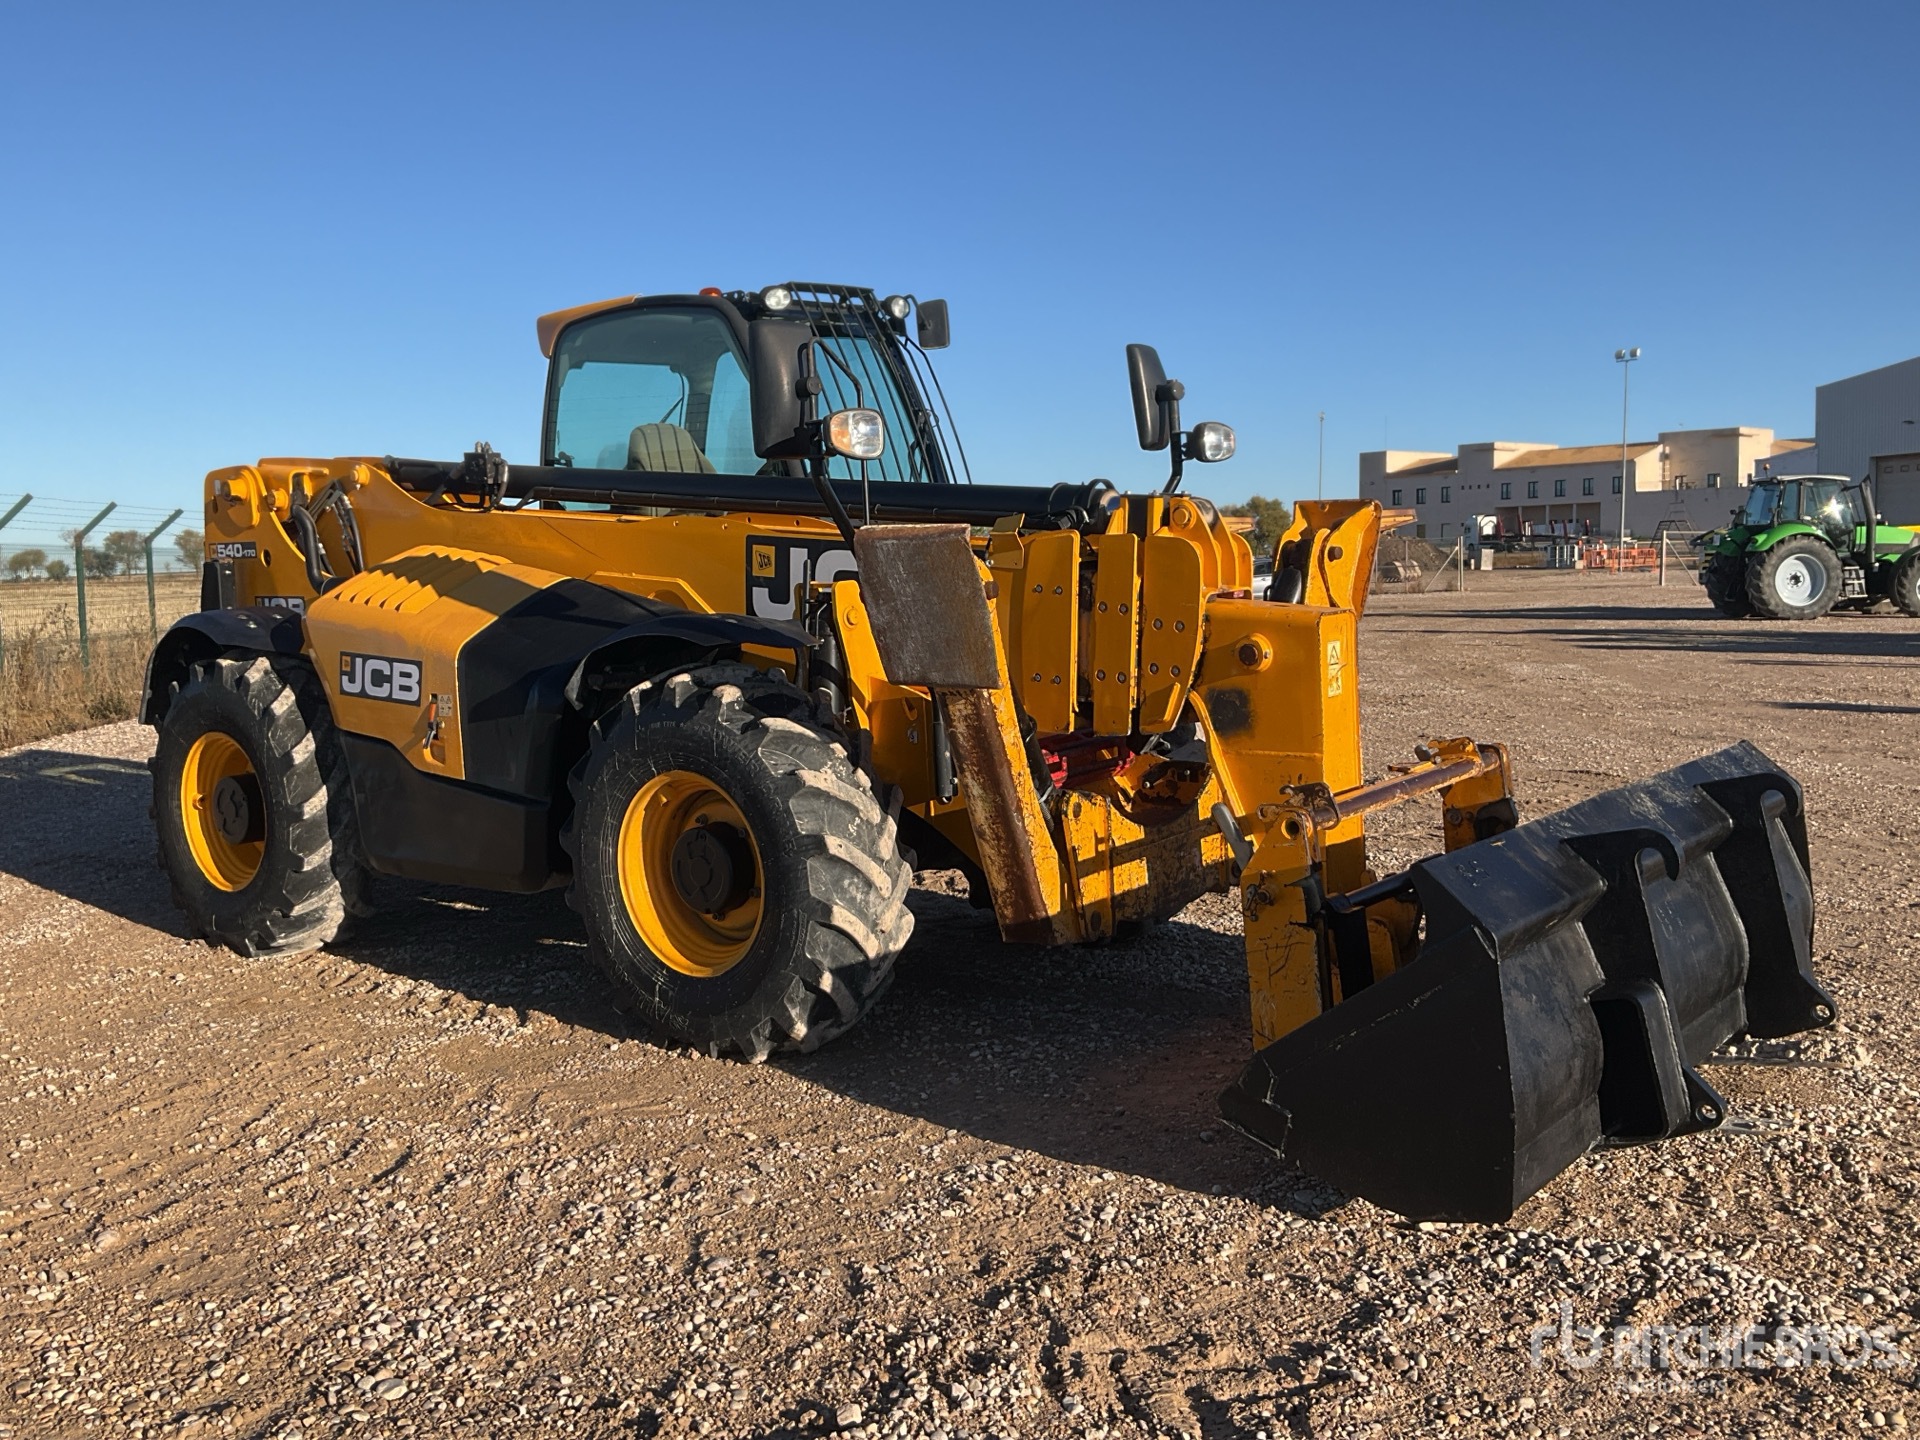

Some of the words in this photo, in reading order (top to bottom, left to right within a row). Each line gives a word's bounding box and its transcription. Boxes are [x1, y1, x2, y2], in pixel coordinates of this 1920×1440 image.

[217, 543, 256, 558] 540-170
[752, 547, 859, 621] JC
[341, 657, 420, 702] JCB
